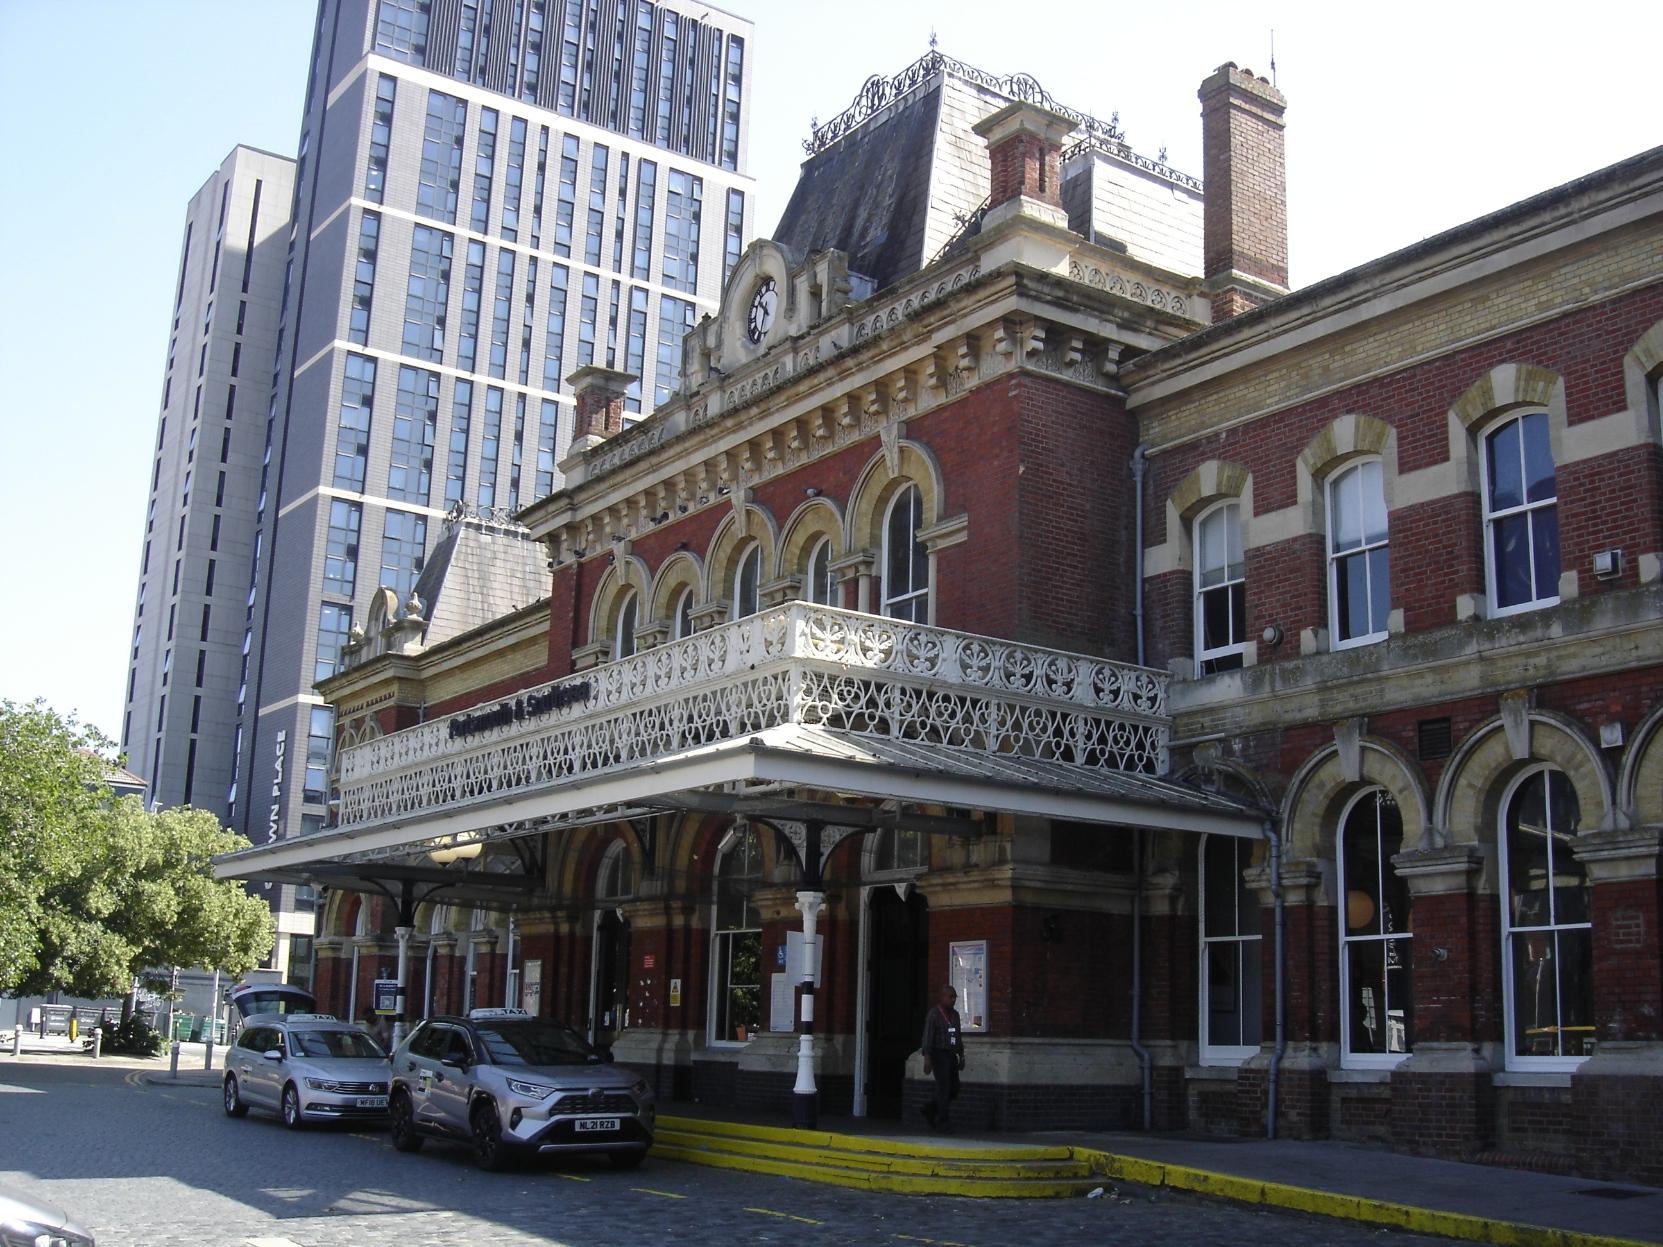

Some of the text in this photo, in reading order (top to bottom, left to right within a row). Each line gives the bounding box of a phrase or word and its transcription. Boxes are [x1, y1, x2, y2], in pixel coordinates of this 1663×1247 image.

[268, 729, 287, 844] WN PLACE
[502, 1008, 528, 1016] TAXI
[579, 1120, 598, 1130] NL21
